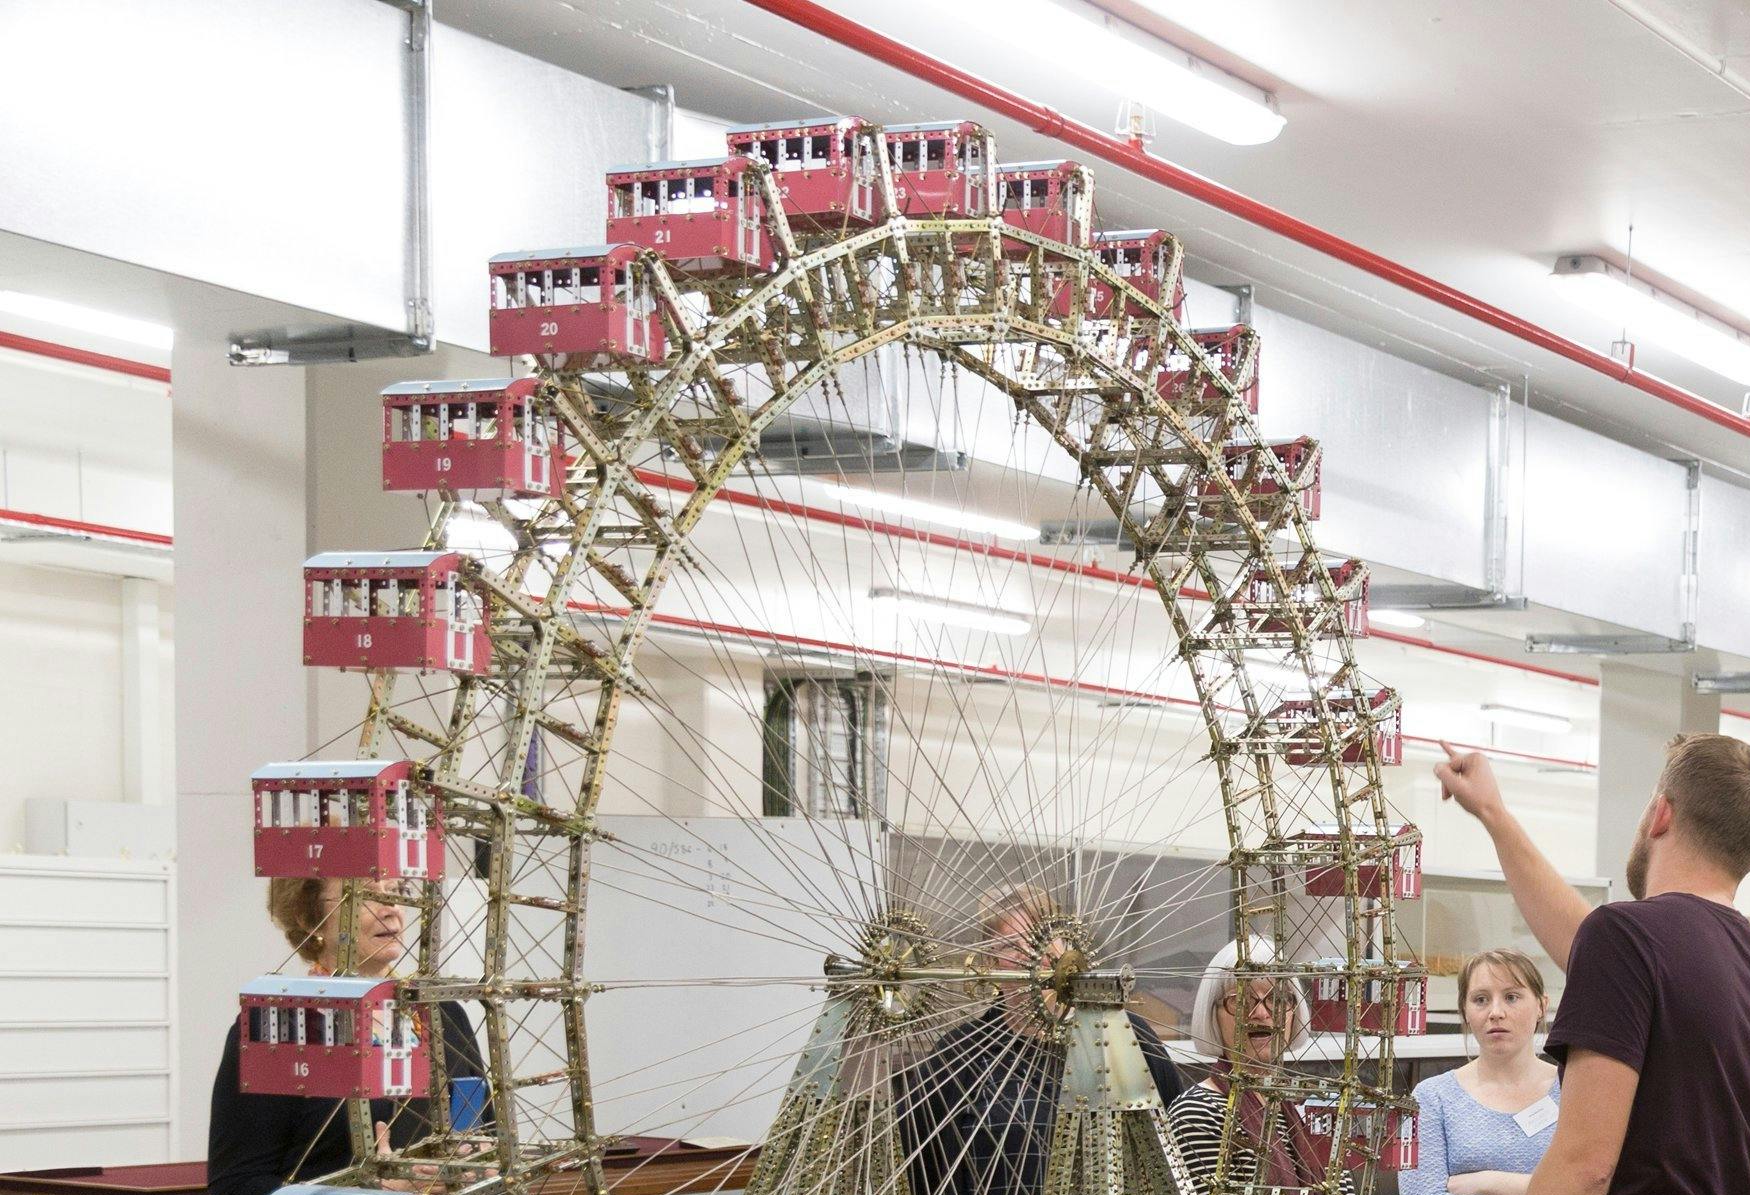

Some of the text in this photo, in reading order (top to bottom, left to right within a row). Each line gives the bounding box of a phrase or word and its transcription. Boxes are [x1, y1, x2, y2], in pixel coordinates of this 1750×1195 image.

[655, 230, 671, 244] 21
[541, 322, 558, 336] 20
[437, 458, 452, 472] 19
[357, 634, 373, 648] 18
[308, 844, 324, 858] 17
[295, 1062, 310, 1077] 16
